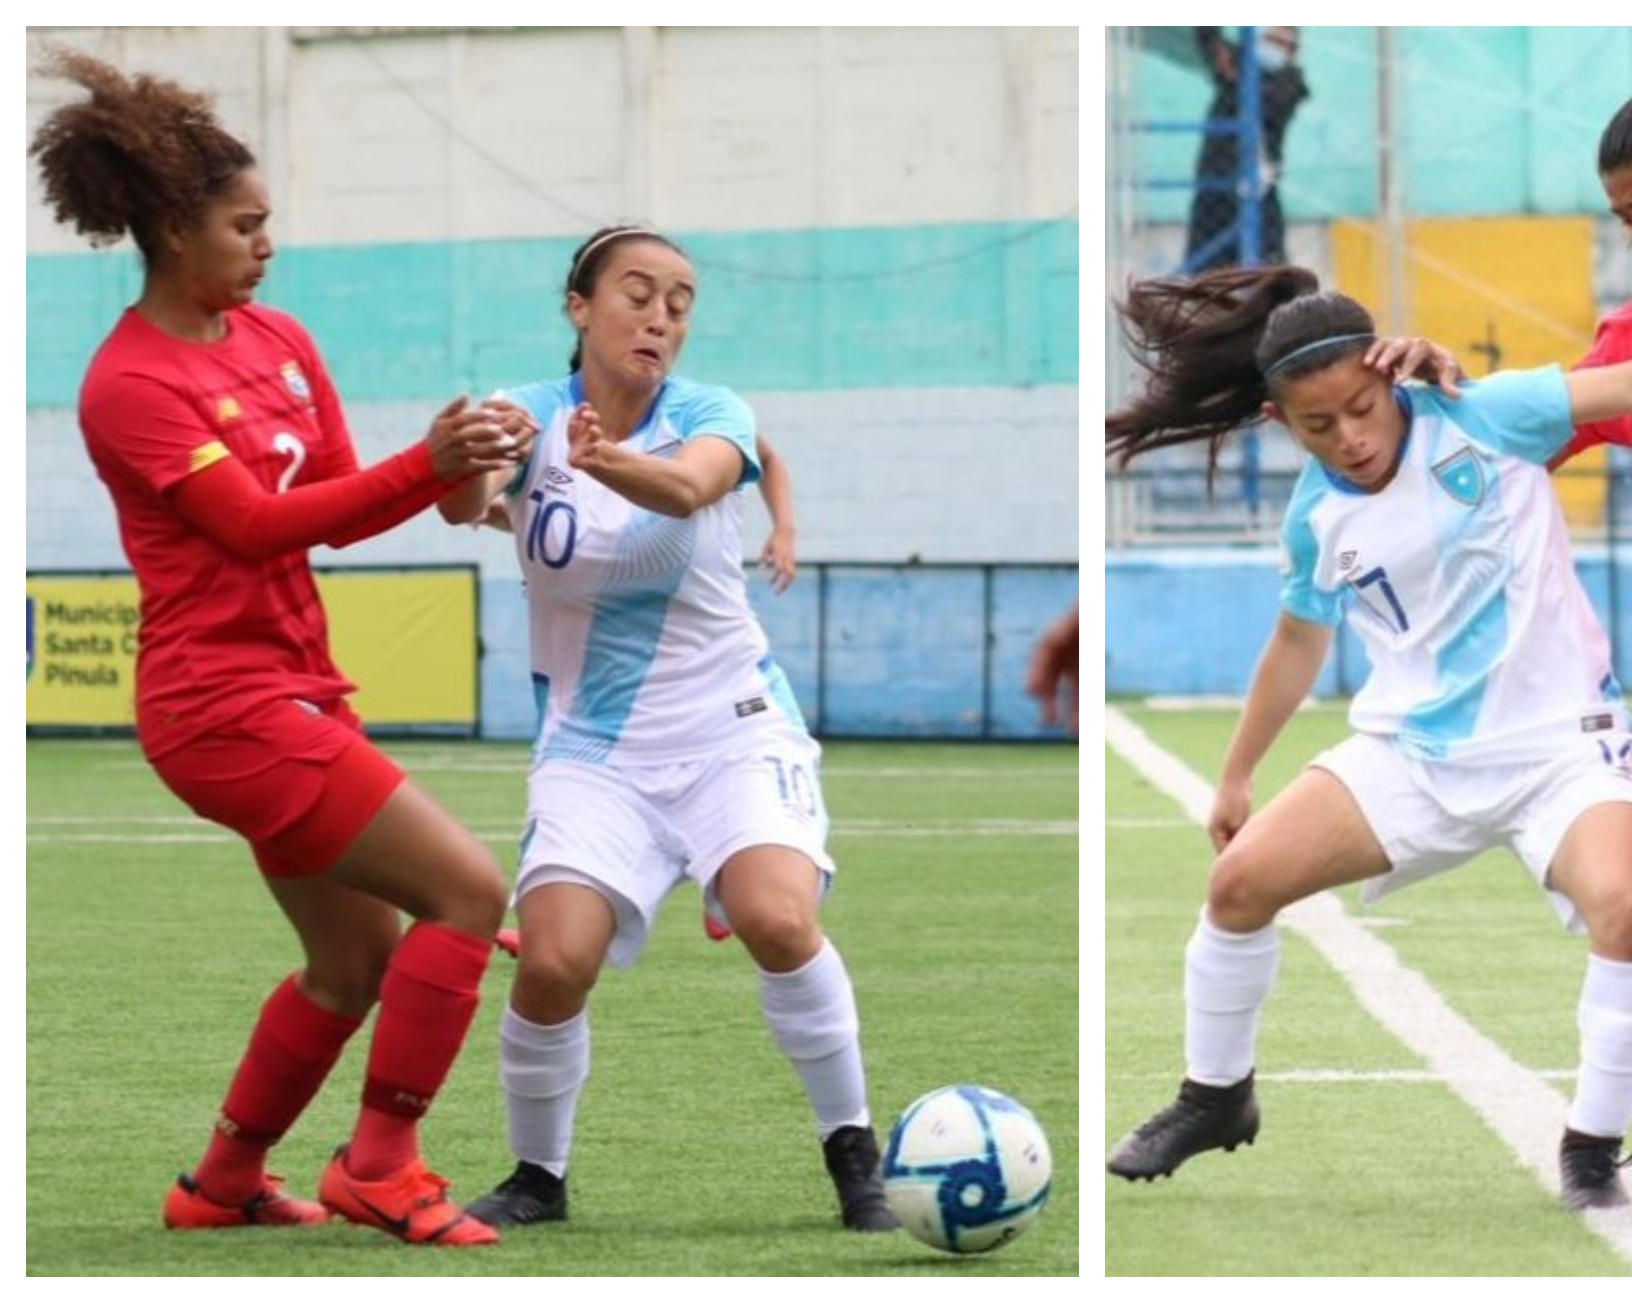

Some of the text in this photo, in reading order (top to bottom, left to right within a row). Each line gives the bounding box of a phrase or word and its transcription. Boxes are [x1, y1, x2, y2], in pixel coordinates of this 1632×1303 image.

[527, 489, 577, 570] 10
[45, 632, 114, 656] Santa
[45, 662, 119, 688] Pinula
[762, 755, 818, 818] 10
